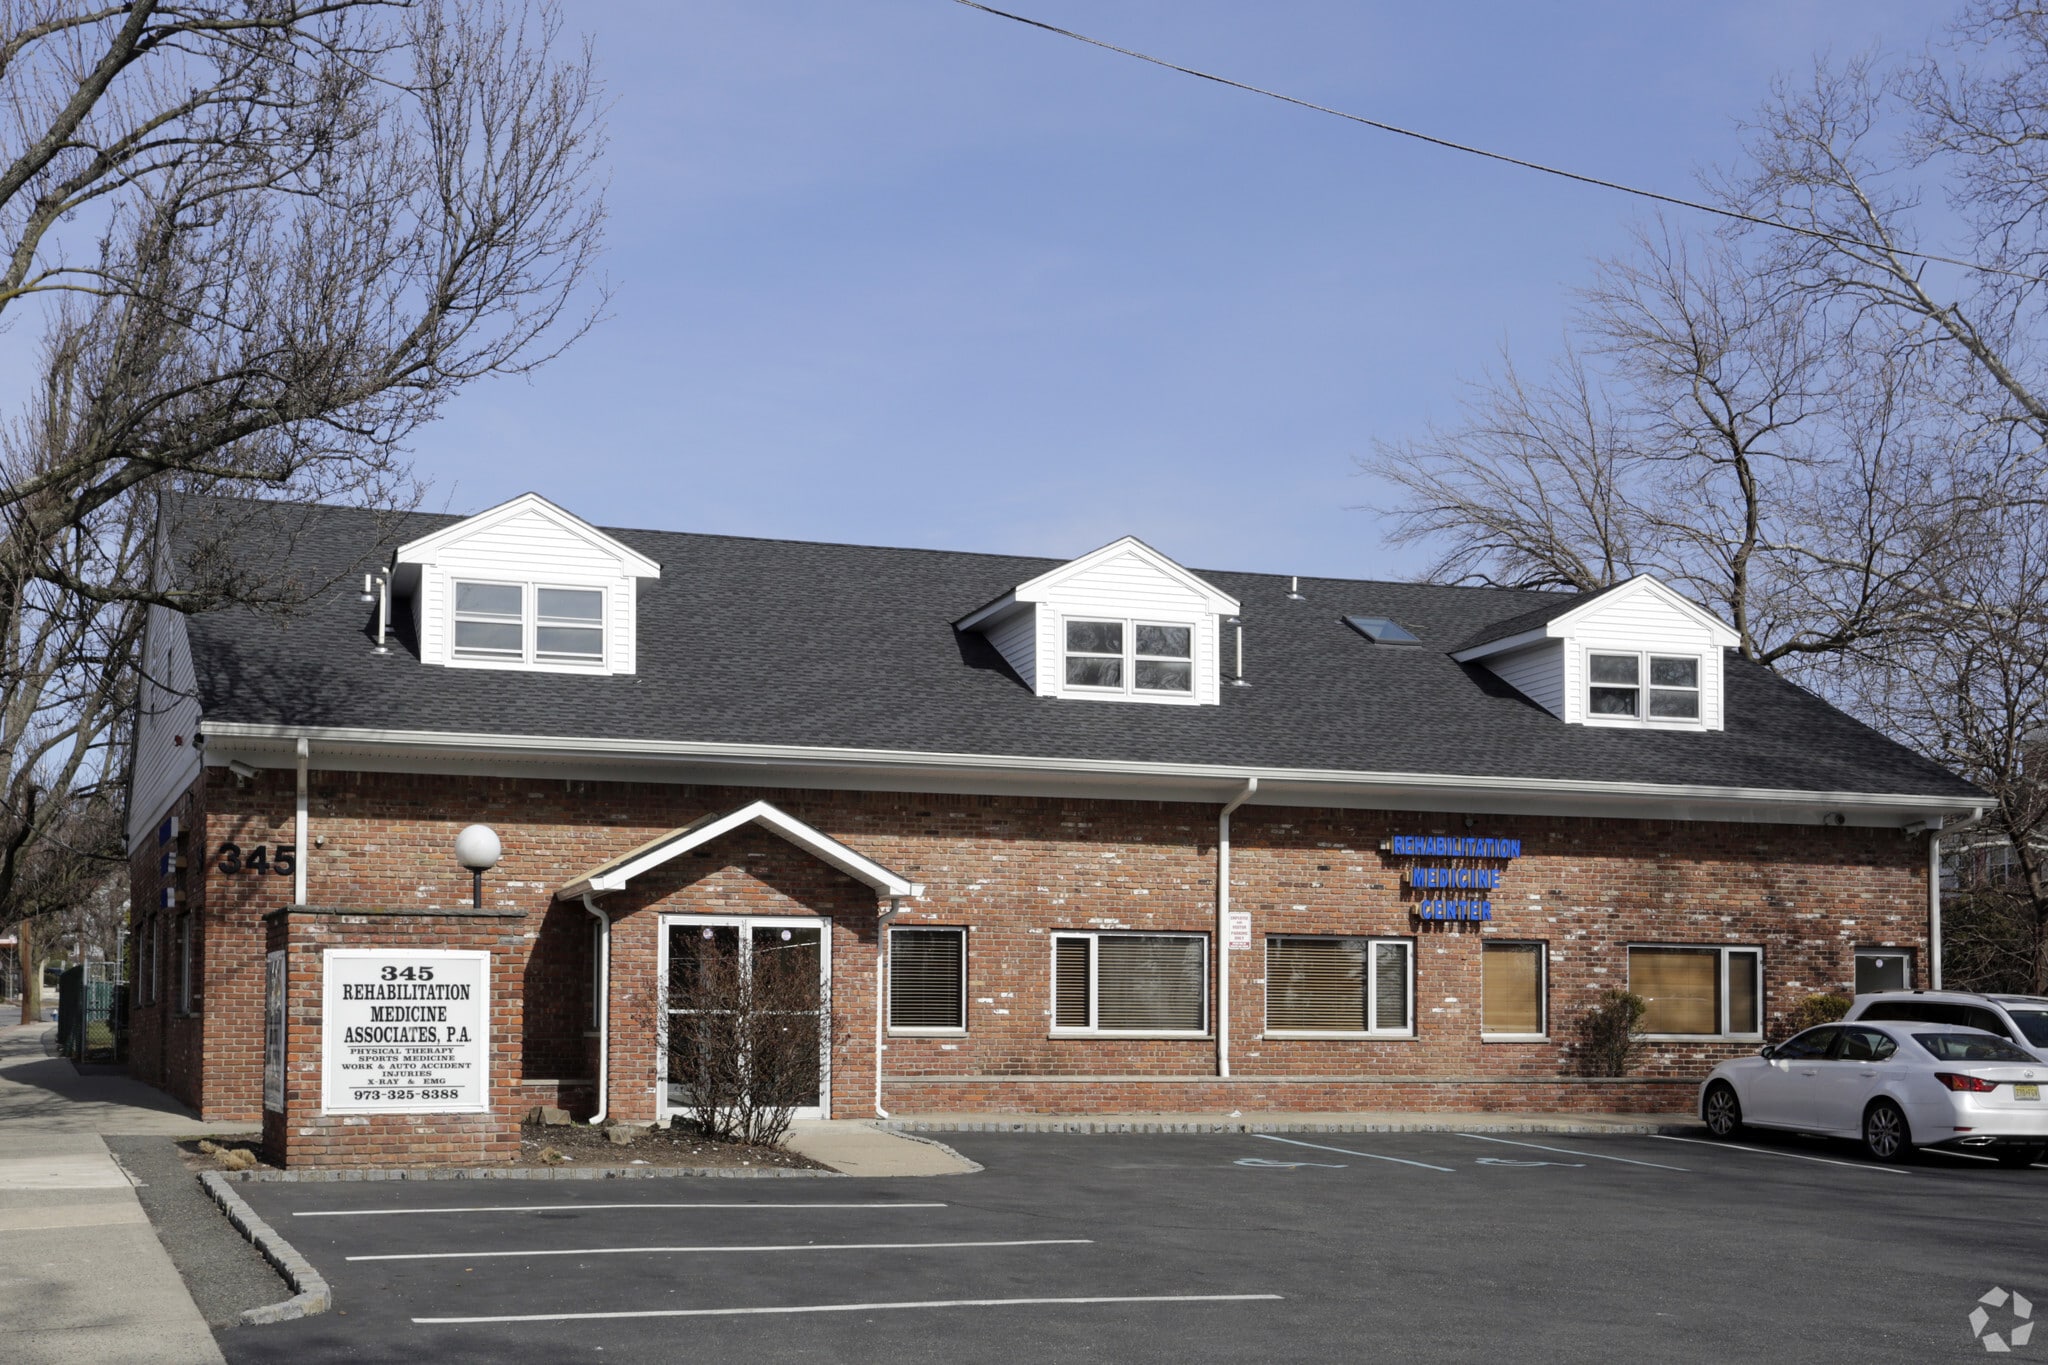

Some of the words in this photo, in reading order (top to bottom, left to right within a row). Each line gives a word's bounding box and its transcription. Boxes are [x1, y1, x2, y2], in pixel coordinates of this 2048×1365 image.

[1392, 835, 1521, 858] REHABILITATION
[219, 843, 296, 876] 345
[1411, 868, 1500, 888] MEDICINE
[1420, 900, 1492, 921] CENTER
[381, 966, 434, 981] 345
[343, 984, 470, 1000] REHABILITATION
[370, 1006, 447, 1022] MEDICINE
[344, 1026, 440, 1044] ASSOCIATES,
[446, 1026, 472, 1043] P.A.
[354, 1089, 459, 1100] 973-325-8388
